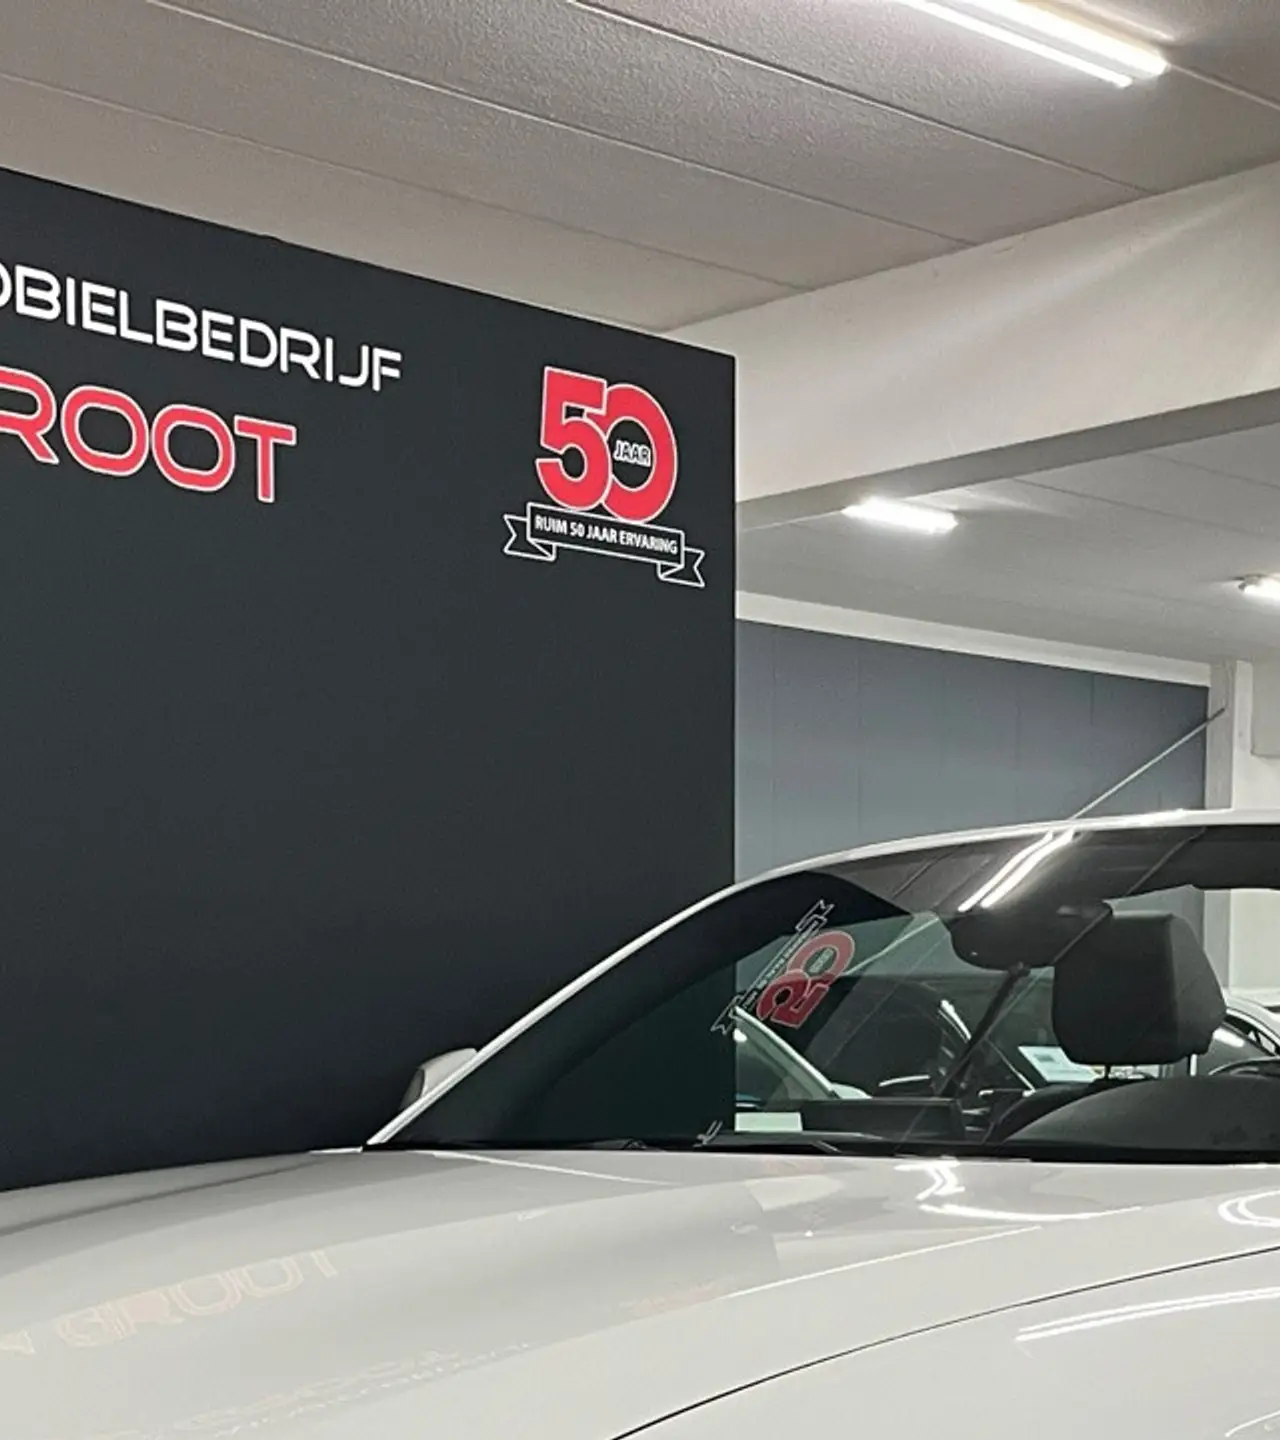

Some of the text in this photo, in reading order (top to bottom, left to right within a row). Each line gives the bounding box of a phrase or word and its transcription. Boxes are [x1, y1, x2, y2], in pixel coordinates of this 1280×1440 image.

[535, 366, 678, 523] 50
[613, 439, 651, 467] JAAR
[534, 514, 678, 555] RUIM 50 JAAR ERVARING
